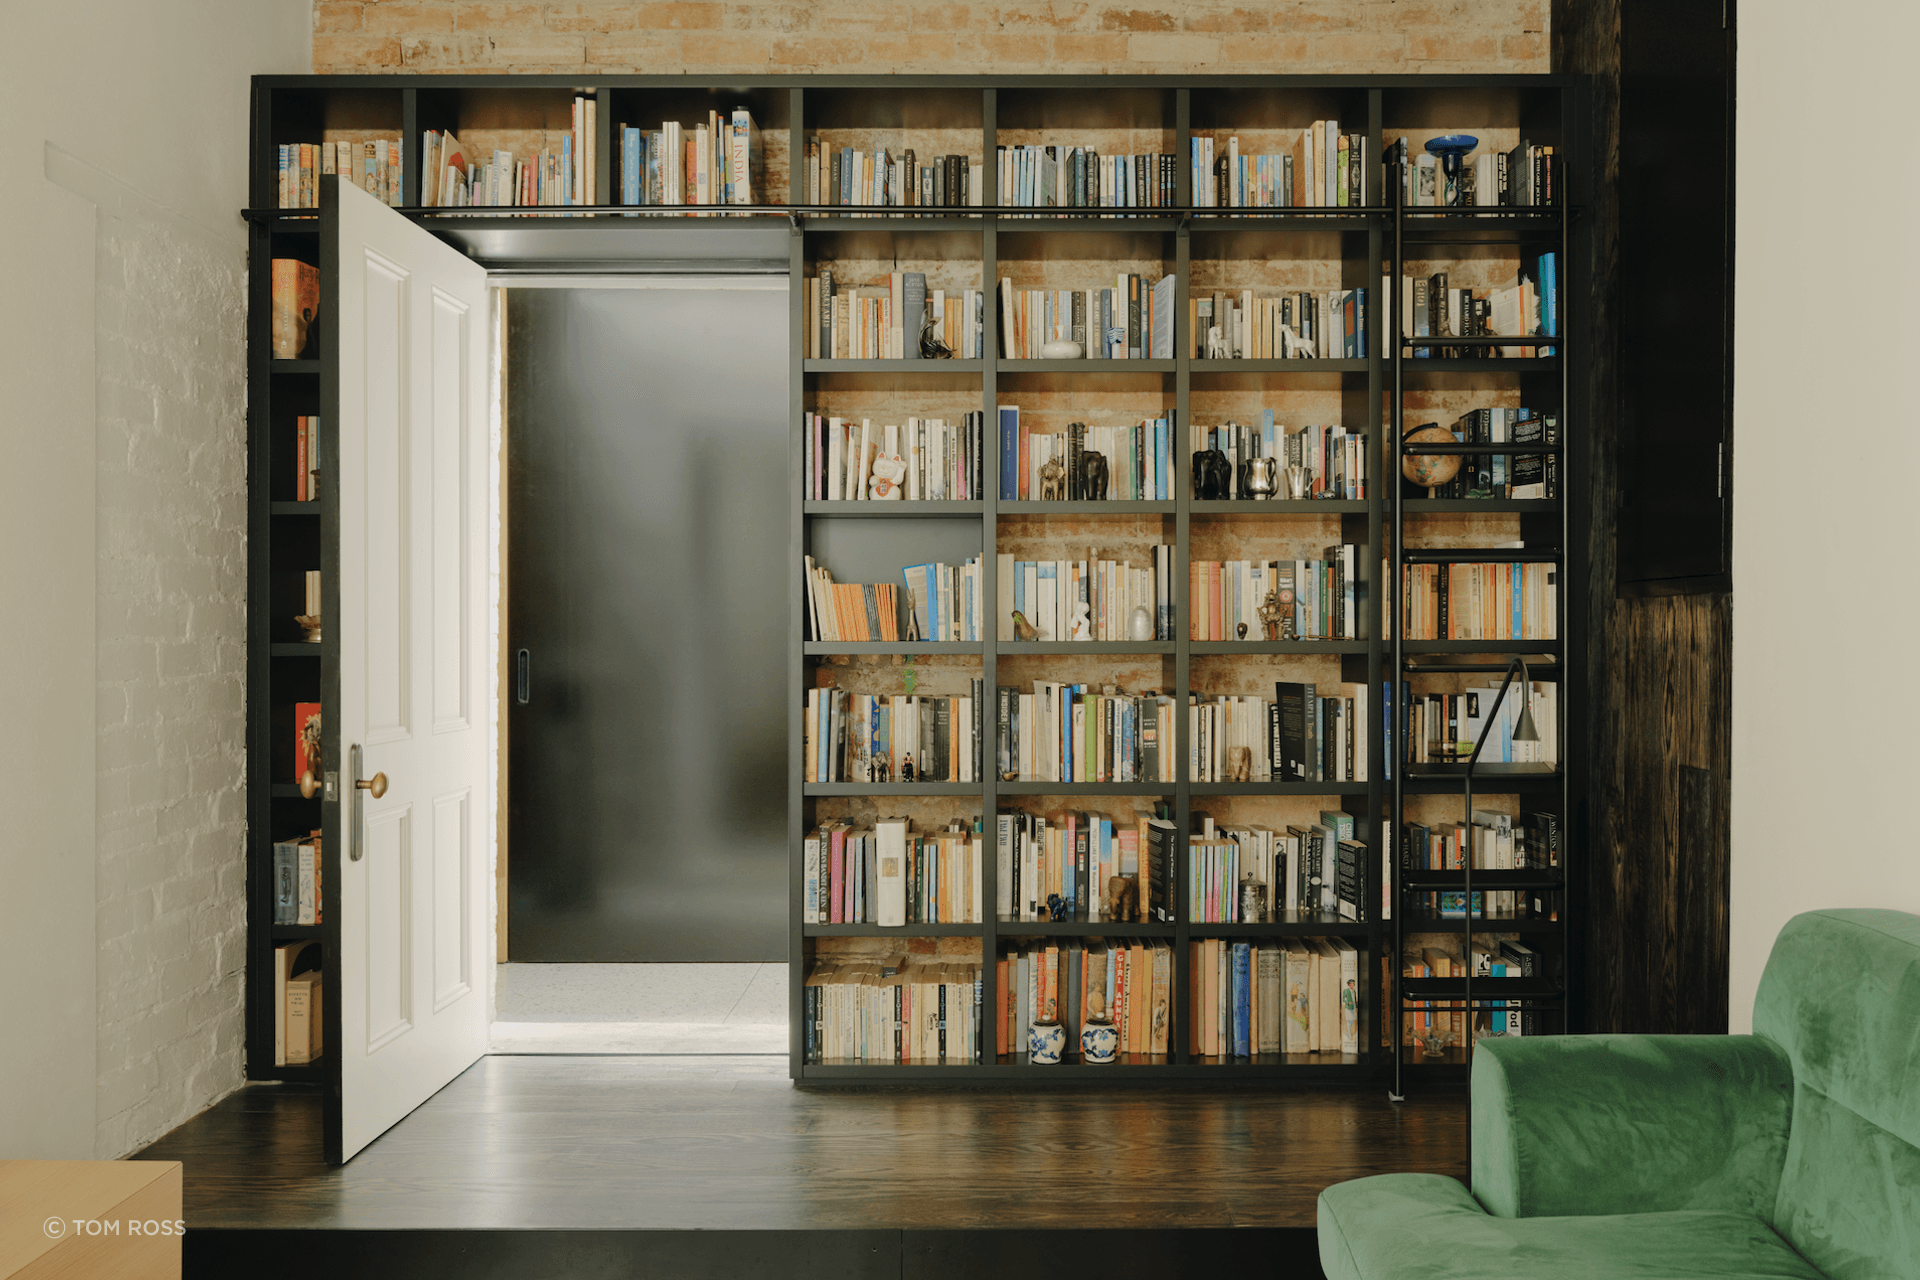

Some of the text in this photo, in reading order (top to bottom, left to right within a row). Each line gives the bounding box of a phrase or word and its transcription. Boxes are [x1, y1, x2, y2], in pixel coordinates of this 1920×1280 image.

[734, 144, 743, 183] INDIA
[1077, 841, 1085, 852] LOGO
[1092, 855, 1097, 863] US
